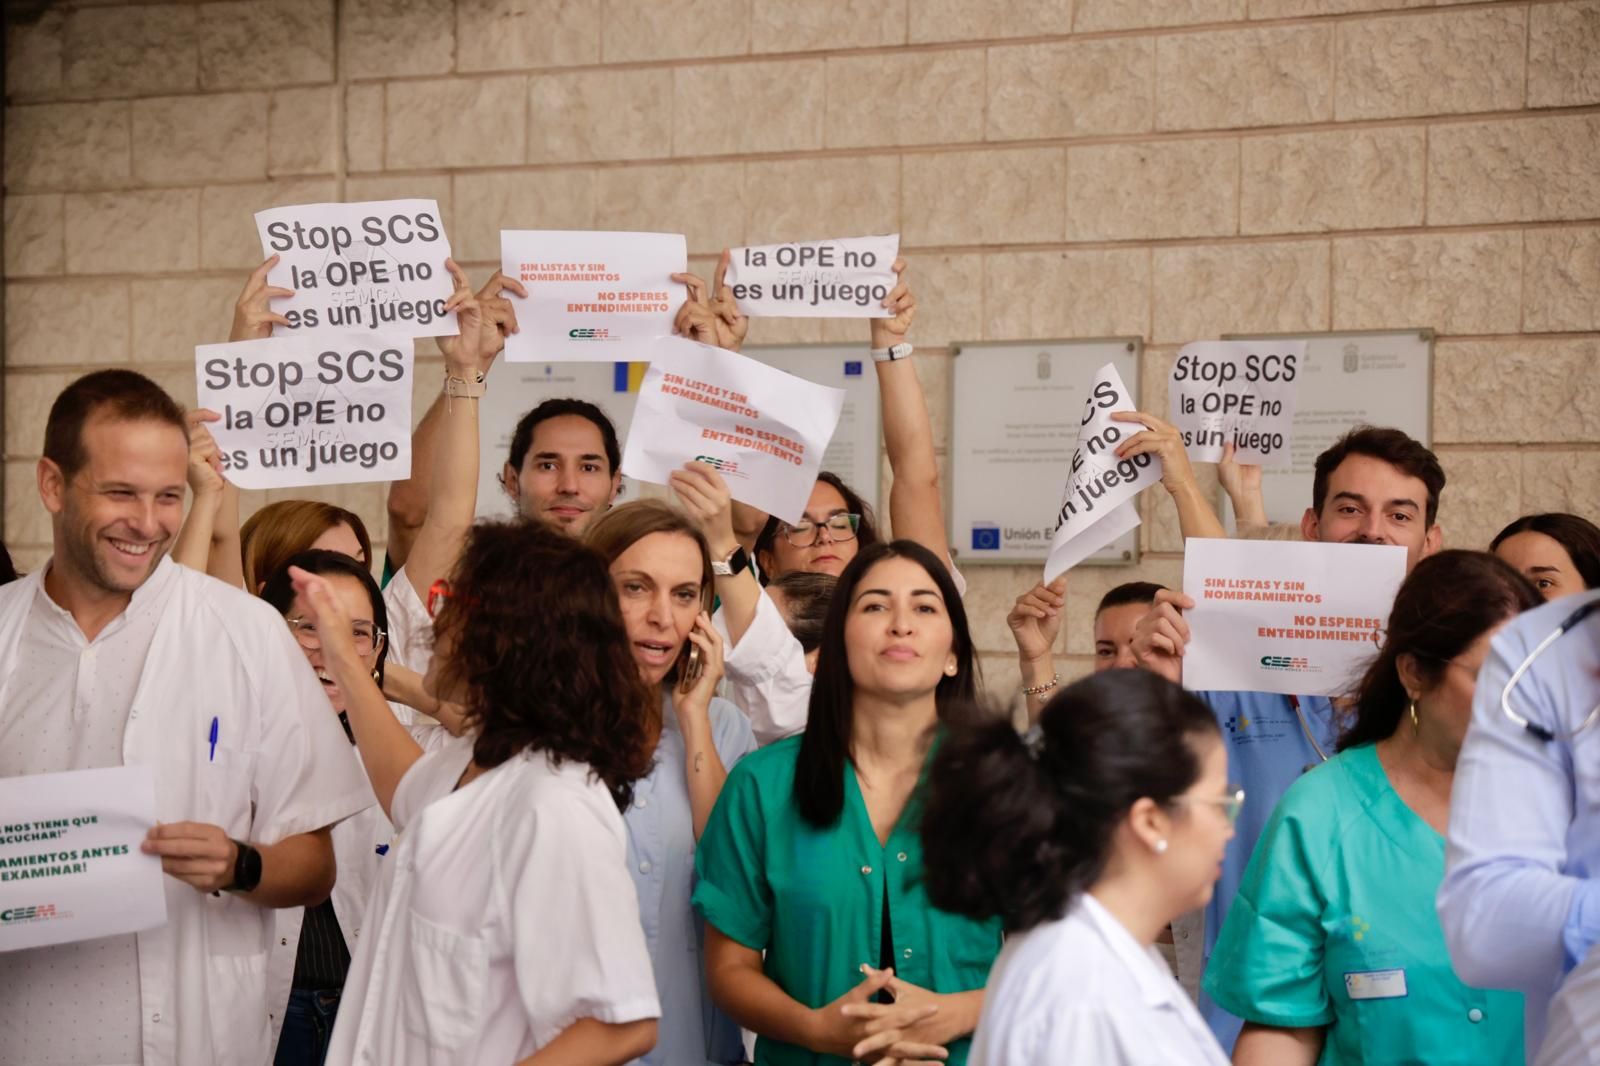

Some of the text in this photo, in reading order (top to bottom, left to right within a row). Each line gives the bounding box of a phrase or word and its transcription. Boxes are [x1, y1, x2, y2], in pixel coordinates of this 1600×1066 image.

[267, 213, 439, 255] Stop SCS
[520, 263, 605, 271] SIN LISTAS Y SIN
[744, 246, 876, 268] la OPE no
[291, 260, 432, 289] la OPE no
[520, 273, 620, 281] NOMBRAMIENTOS
[598, 292, 668, 301] NO ESPERES
[732, 279, 887, 306] es un juego
[285, 298, 447, 329] es un juego
[567, 303, 669, 312] ENTENDIMIENTO
[205, 350, 404, 395] Stop SCS
[1174, 354, 1296, 387] Stop SCS
[661, 384, 759, 419] NOMBRAMIENTOS
[664, 373, 747, 404] SIN LISTAS Y SIN
[225, 400, 385, 430] la OPE no
[1181, 392, 1282, 416] la OPE no
[702, 428, 802, 466] ENTENDIMIENTO
[735, 424, 805, 454] NO ESPERES
[1087, 427, 1121, 455] no
[1180, 431, 1192, 447] s
[1196, 429, 1225, 447] un
[1233, 427, 1283, 455] juego
[260, 446, 297, 468] un
[306, 440, 398, 472] juego
[1076, 452, 1151, 512] juego
[1004, 528, 1041, 541] Unión
[1204, 578, 1304, 591] SIN LISTAS Y SIN
[1204, 590, 1322, 603] NOMBRAMIENTOS
[1258, 627, 1381, 642] ENTENDIMIENTO
[1294, 616, 1381, 629] NO ESPERES
[4, 823, 31, 834] NOS
[33, 819, 69, 830] TIENE
[72, 815, 98, 827] QUE
[0, 844, 129, 868] AMIENTOS ANTES
[1, 862, 87, 881] EXAMINAR!
